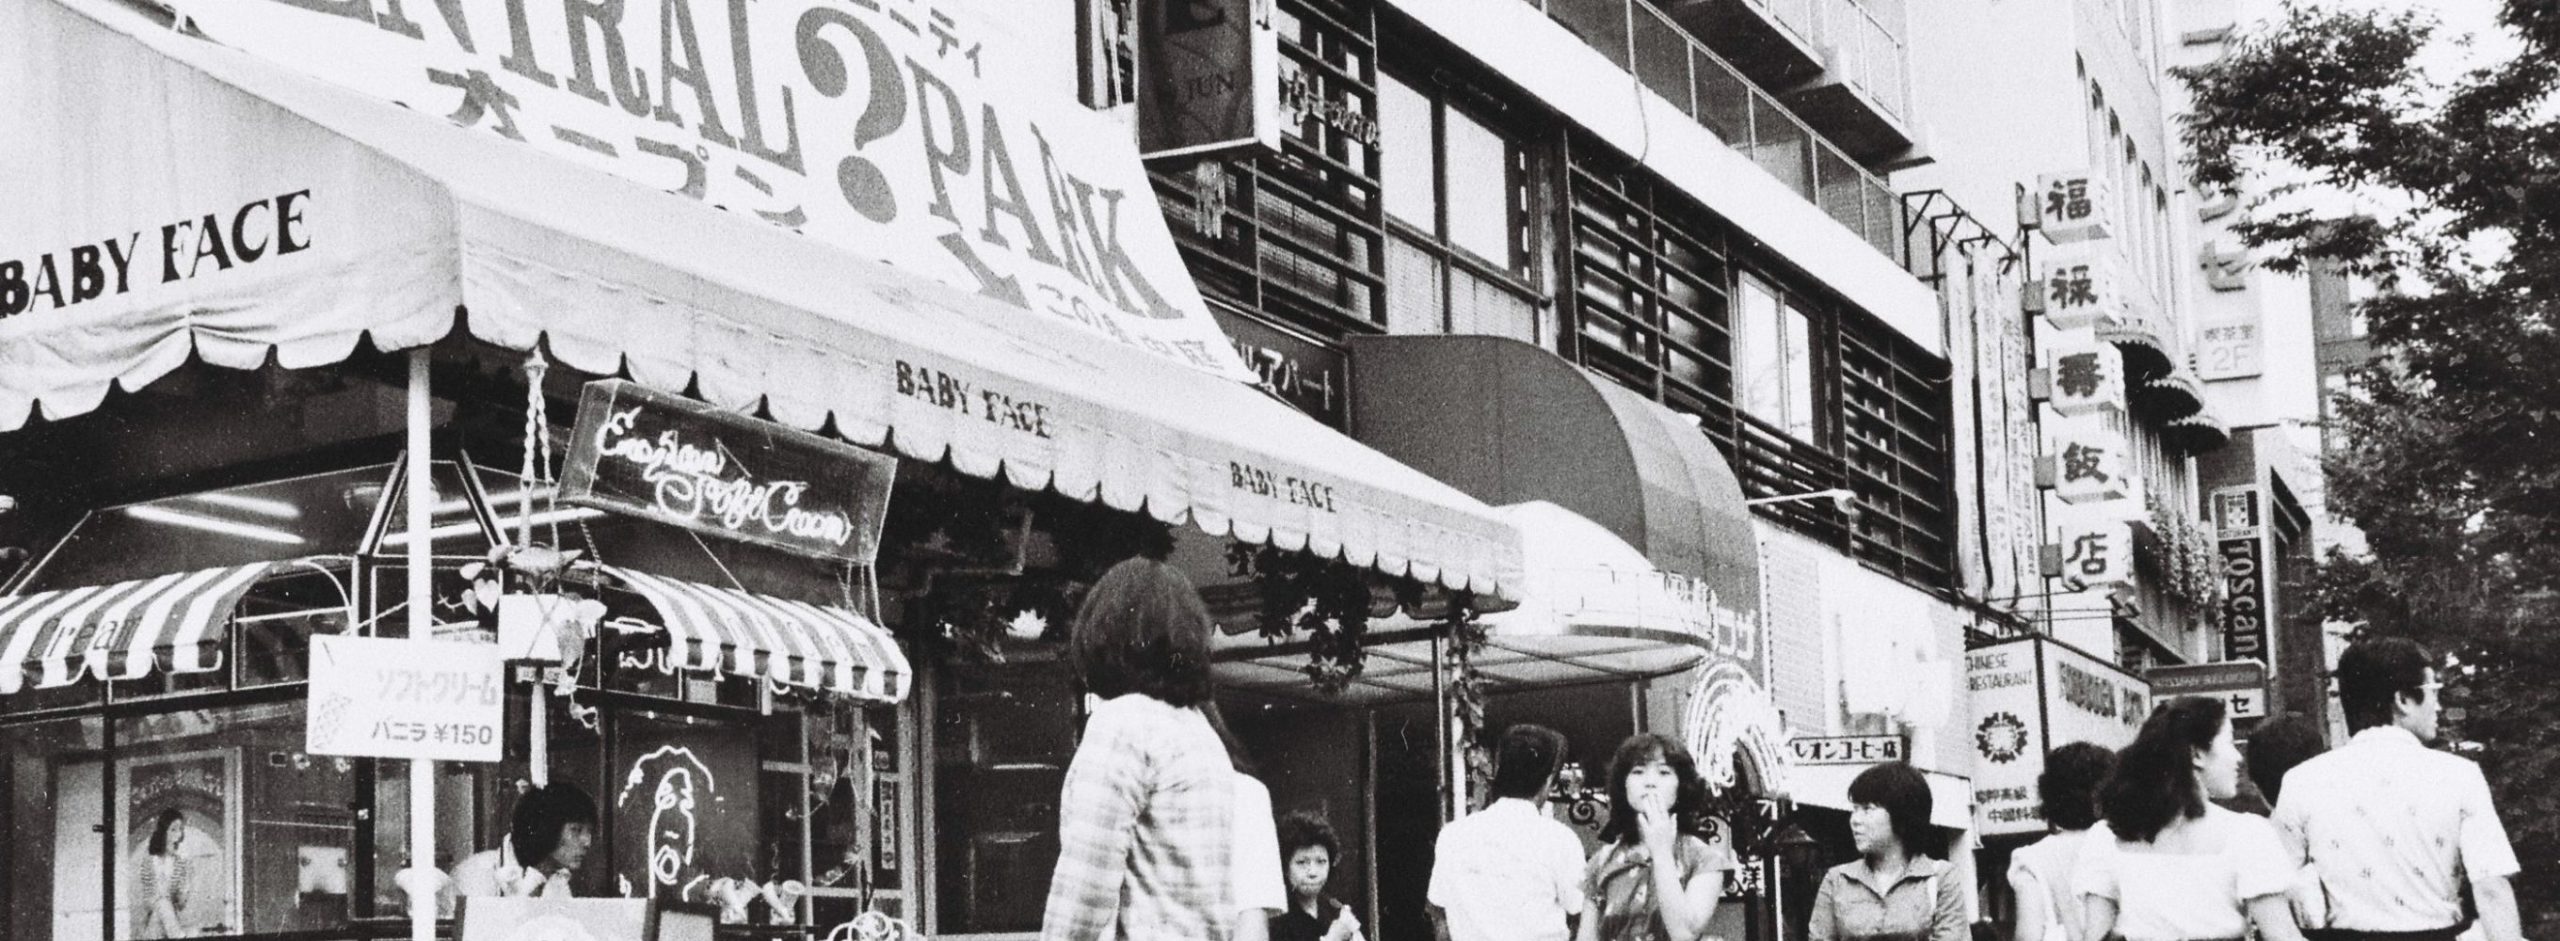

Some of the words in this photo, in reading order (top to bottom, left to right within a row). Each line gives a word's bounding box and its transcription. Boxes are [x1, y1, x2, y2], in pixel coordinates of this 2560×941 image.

[0, 232, 140, 320] BABY
[161, 189, 311, 284] FACE
[2211, 344, 2250, 371] 2F
[895, 360, 970, 415] BABY
[983, 389, 1051, 439] FACE
[1230, 460, 1282, 498] BABY
[1286, 477, 1338, 513] FACE
[377, 669, 497, 705] ソフトクリーム
[434, 723, 493, 745] ¥150
